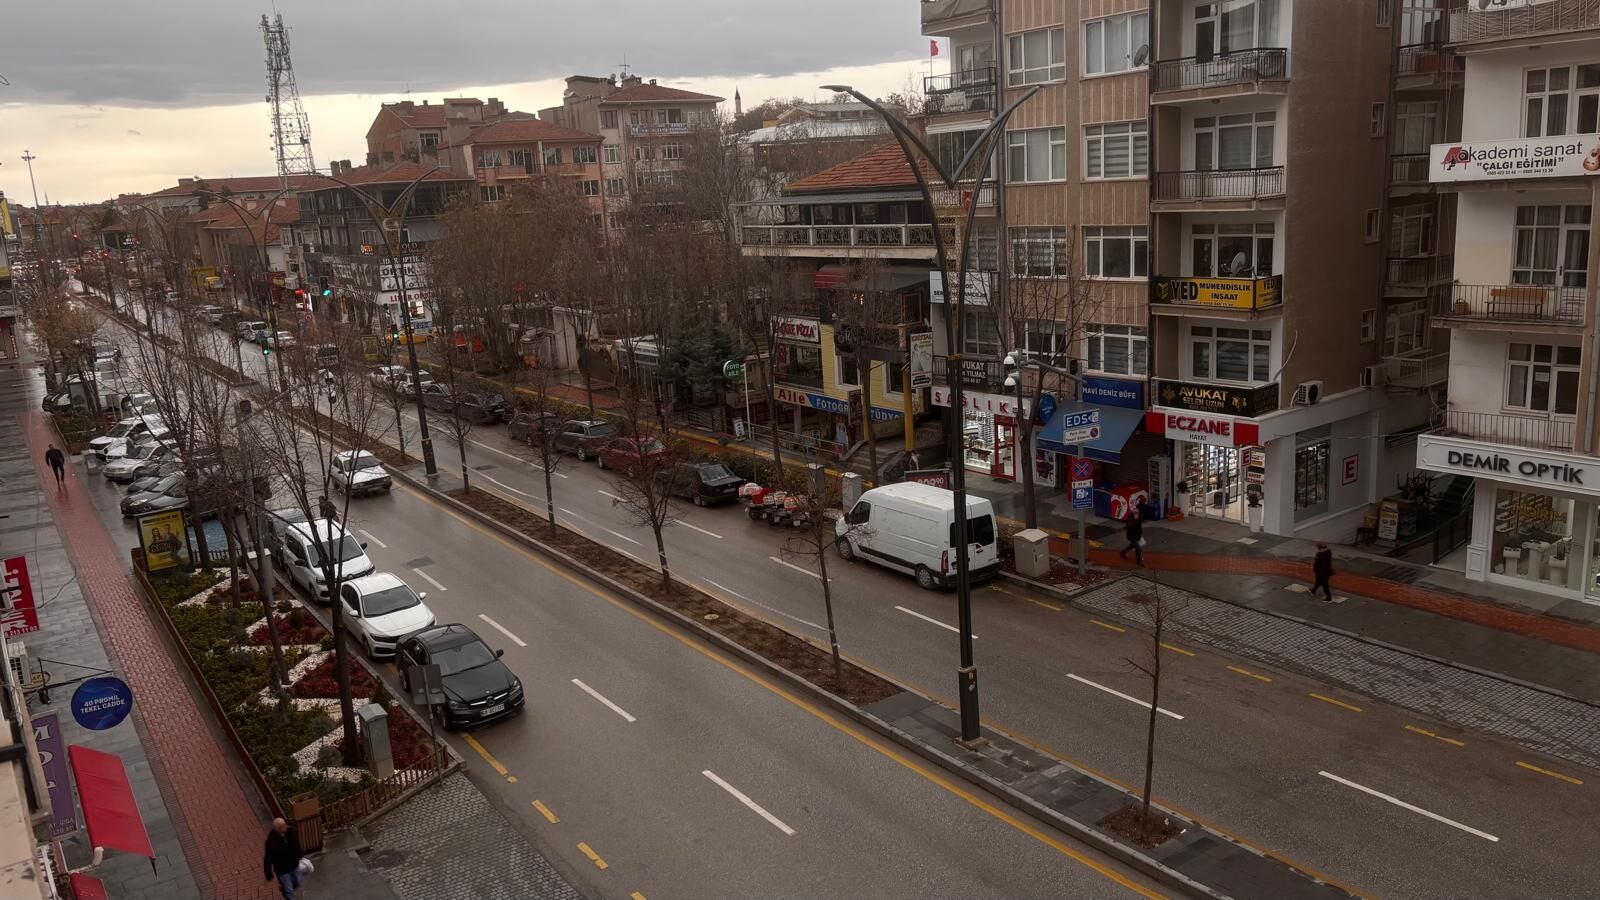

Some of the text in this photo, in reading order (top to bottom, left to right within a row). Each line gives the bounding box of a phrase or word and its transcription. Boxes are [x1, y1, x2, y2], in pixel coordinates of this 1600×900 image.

[1458, 141, 1583, 161] akademi sanat
[1170, 281, 1199, 300] YED
[961, 360, 985, 371] VUKAT
[778, 389, 806, 404] Aile
[816, 396, 849, 413] FOTOĞR
[1179, 386, 1229, 401] AVUKAT
[1066, 413, 1088, 427] EDS
[1167, 414, 1231, 436] ECZANE
[1189, 433, 1207, 441] HAYAT
[1345, 460, 1356, 480] E
[1447, 450, 1584, 485] DEMİR OPTİK
[80, 699, 125, 714] TEKEL CADDE
